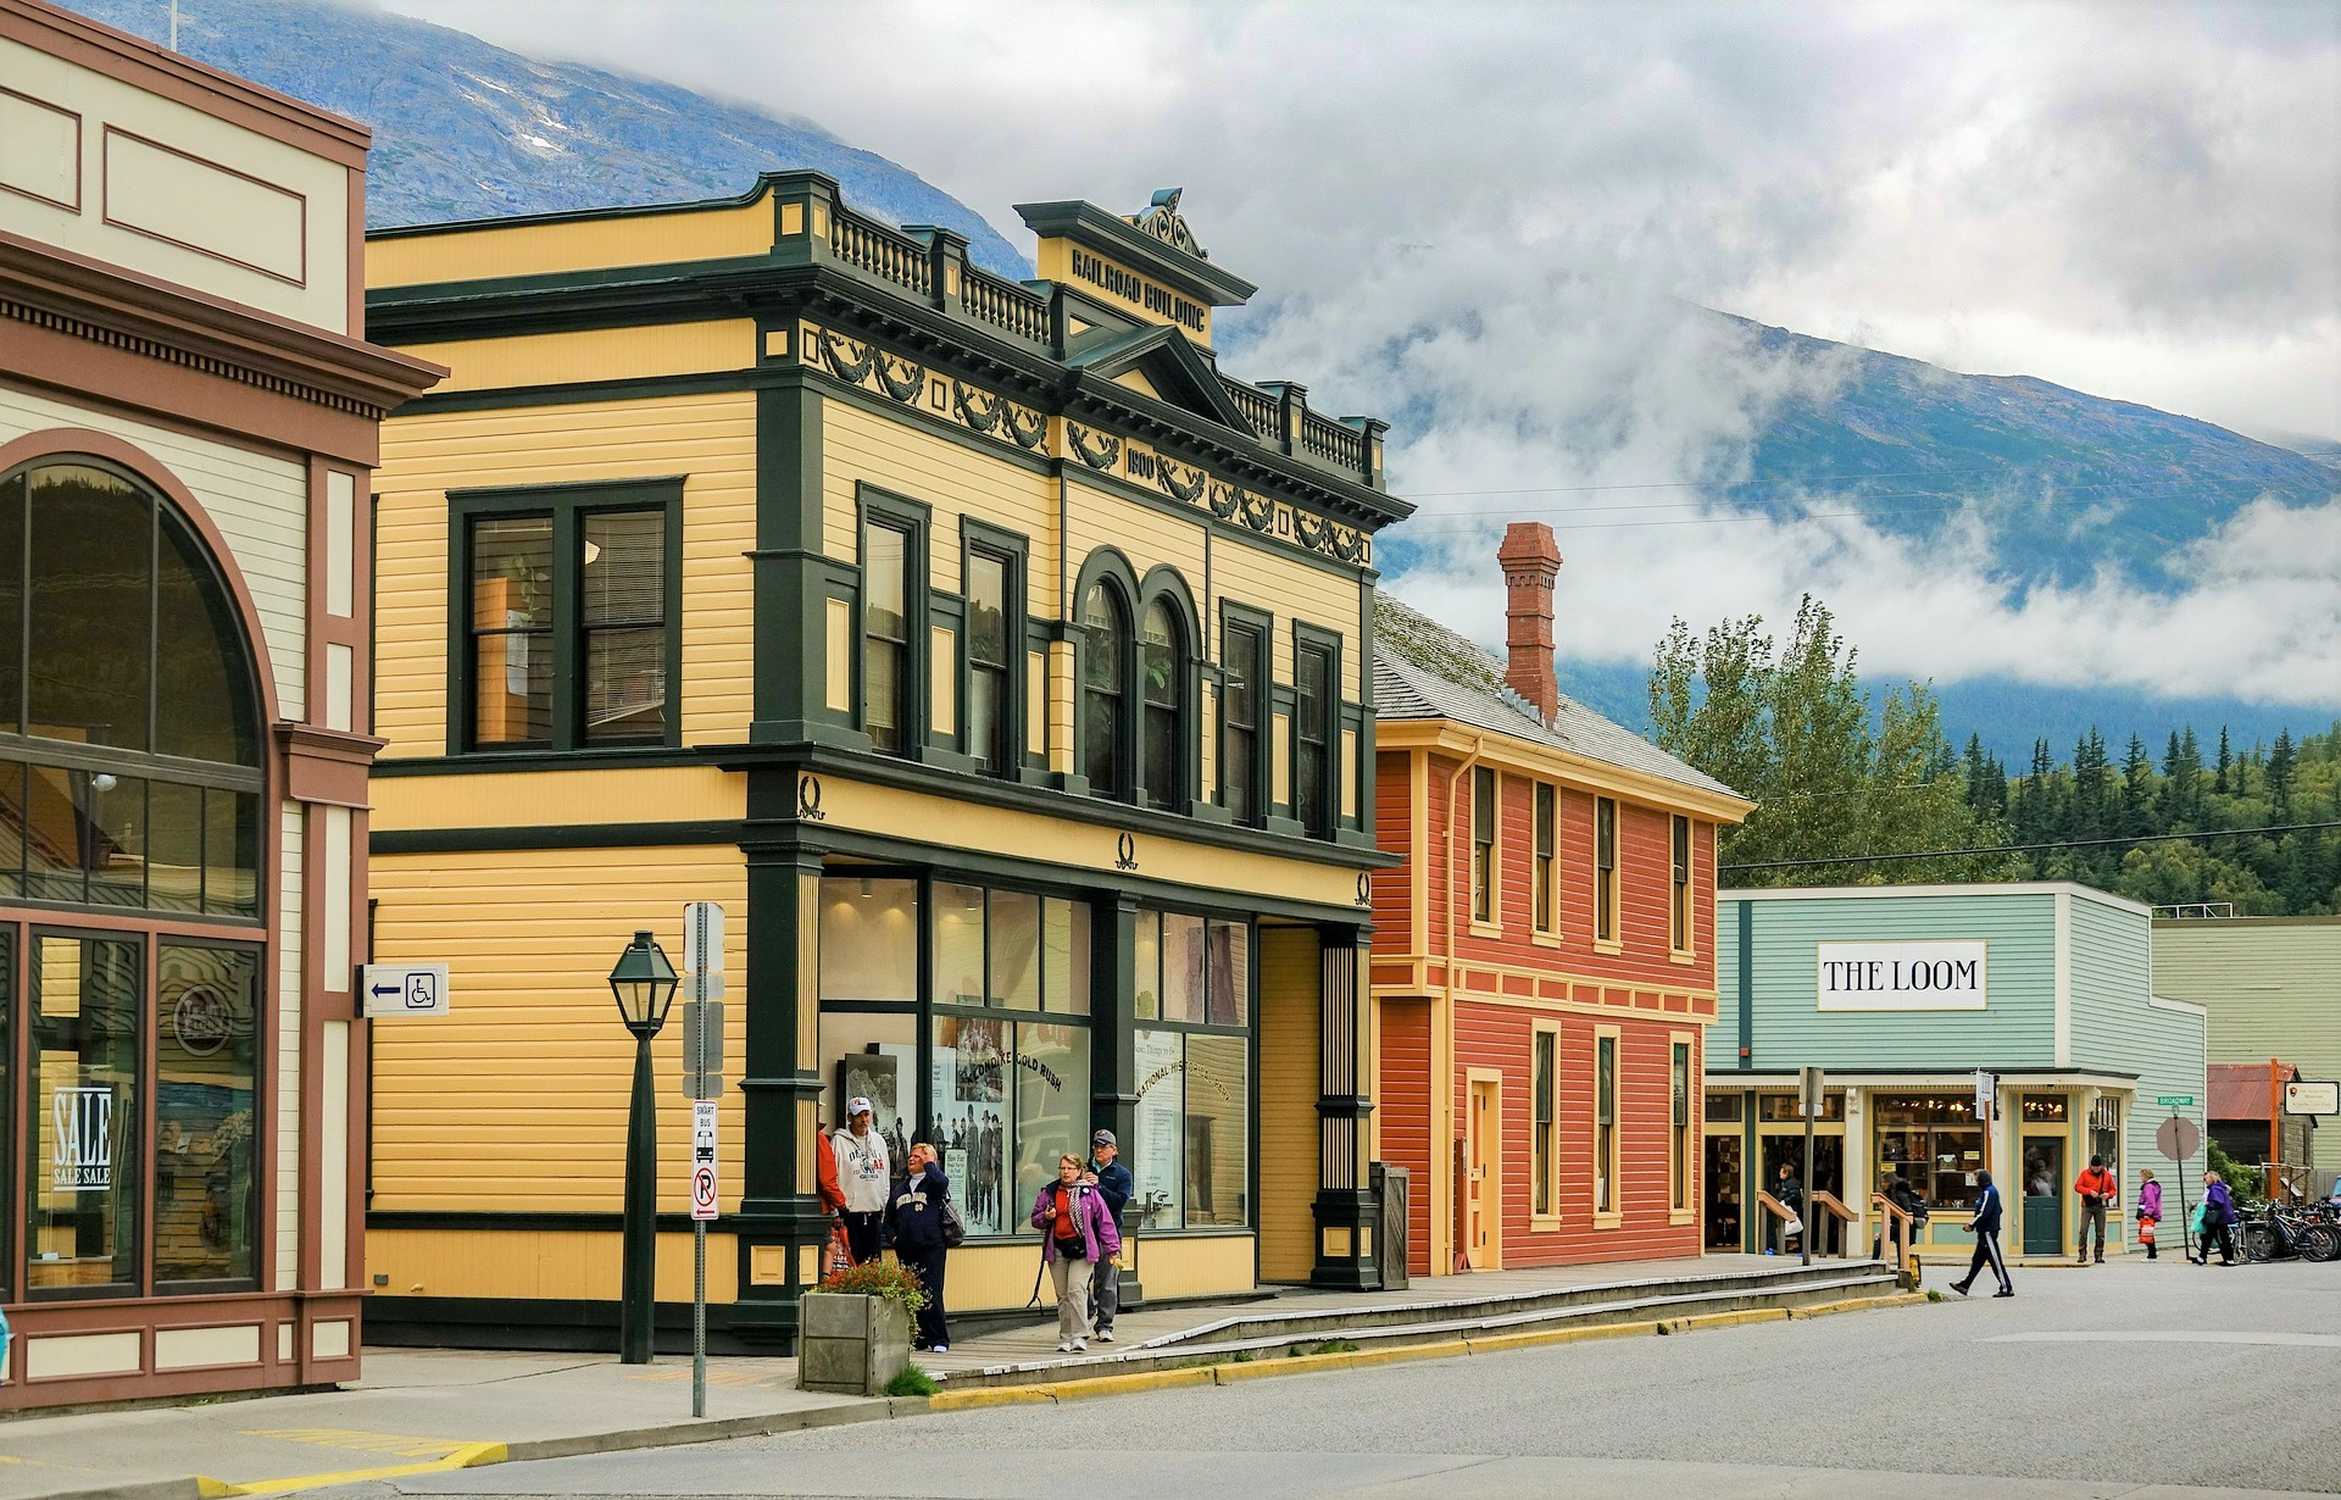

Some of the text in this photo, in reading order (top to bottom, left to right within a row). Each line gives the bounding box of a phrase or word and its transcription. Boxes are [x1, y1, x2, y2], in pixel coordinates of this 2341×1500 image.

[1072, 249, 1205, 332] RAILROAD BUILDING
[1127, 447, 1154, 480] 1900
[1823, 960, 1978, 991] THE LOOM
[1016, 1052, 1039, 1072] GOLD
[1039, 1064, 1062, 1092] RUSH
[1136, 1066, 1169, 1098] NATIONAL
[54, 1092, 112, 1166] SALE
[700, 1118, 711, 1127] BUS
[54, 1167, 111, 1185] SALE SALE
